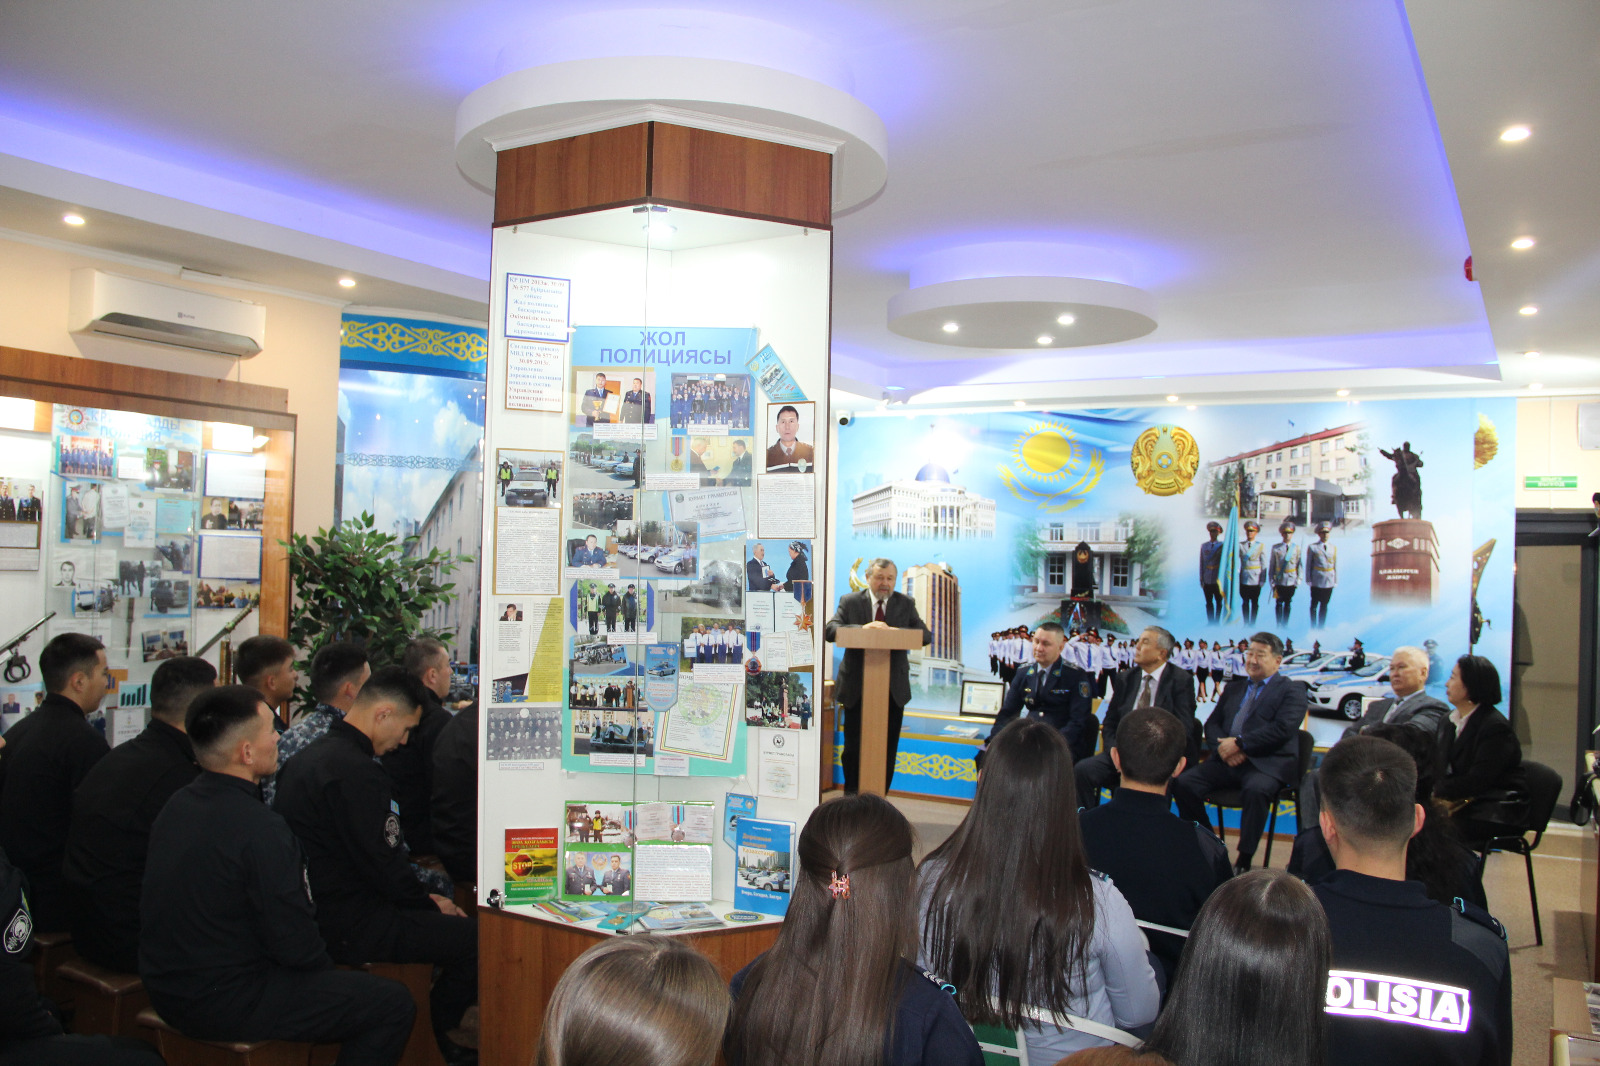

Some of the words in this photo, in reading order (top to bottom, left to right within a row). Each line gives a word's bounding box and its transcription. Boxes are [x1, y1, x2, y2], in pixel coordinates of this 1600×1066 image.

[640, 331, 686, 346] ЖОЛ
[600, 348, 732, 366] ПОЛИЦИЯСЫ
[512, 861, 532, 870] STOP
[1326, 976, 1462, 1025] OLISIA
